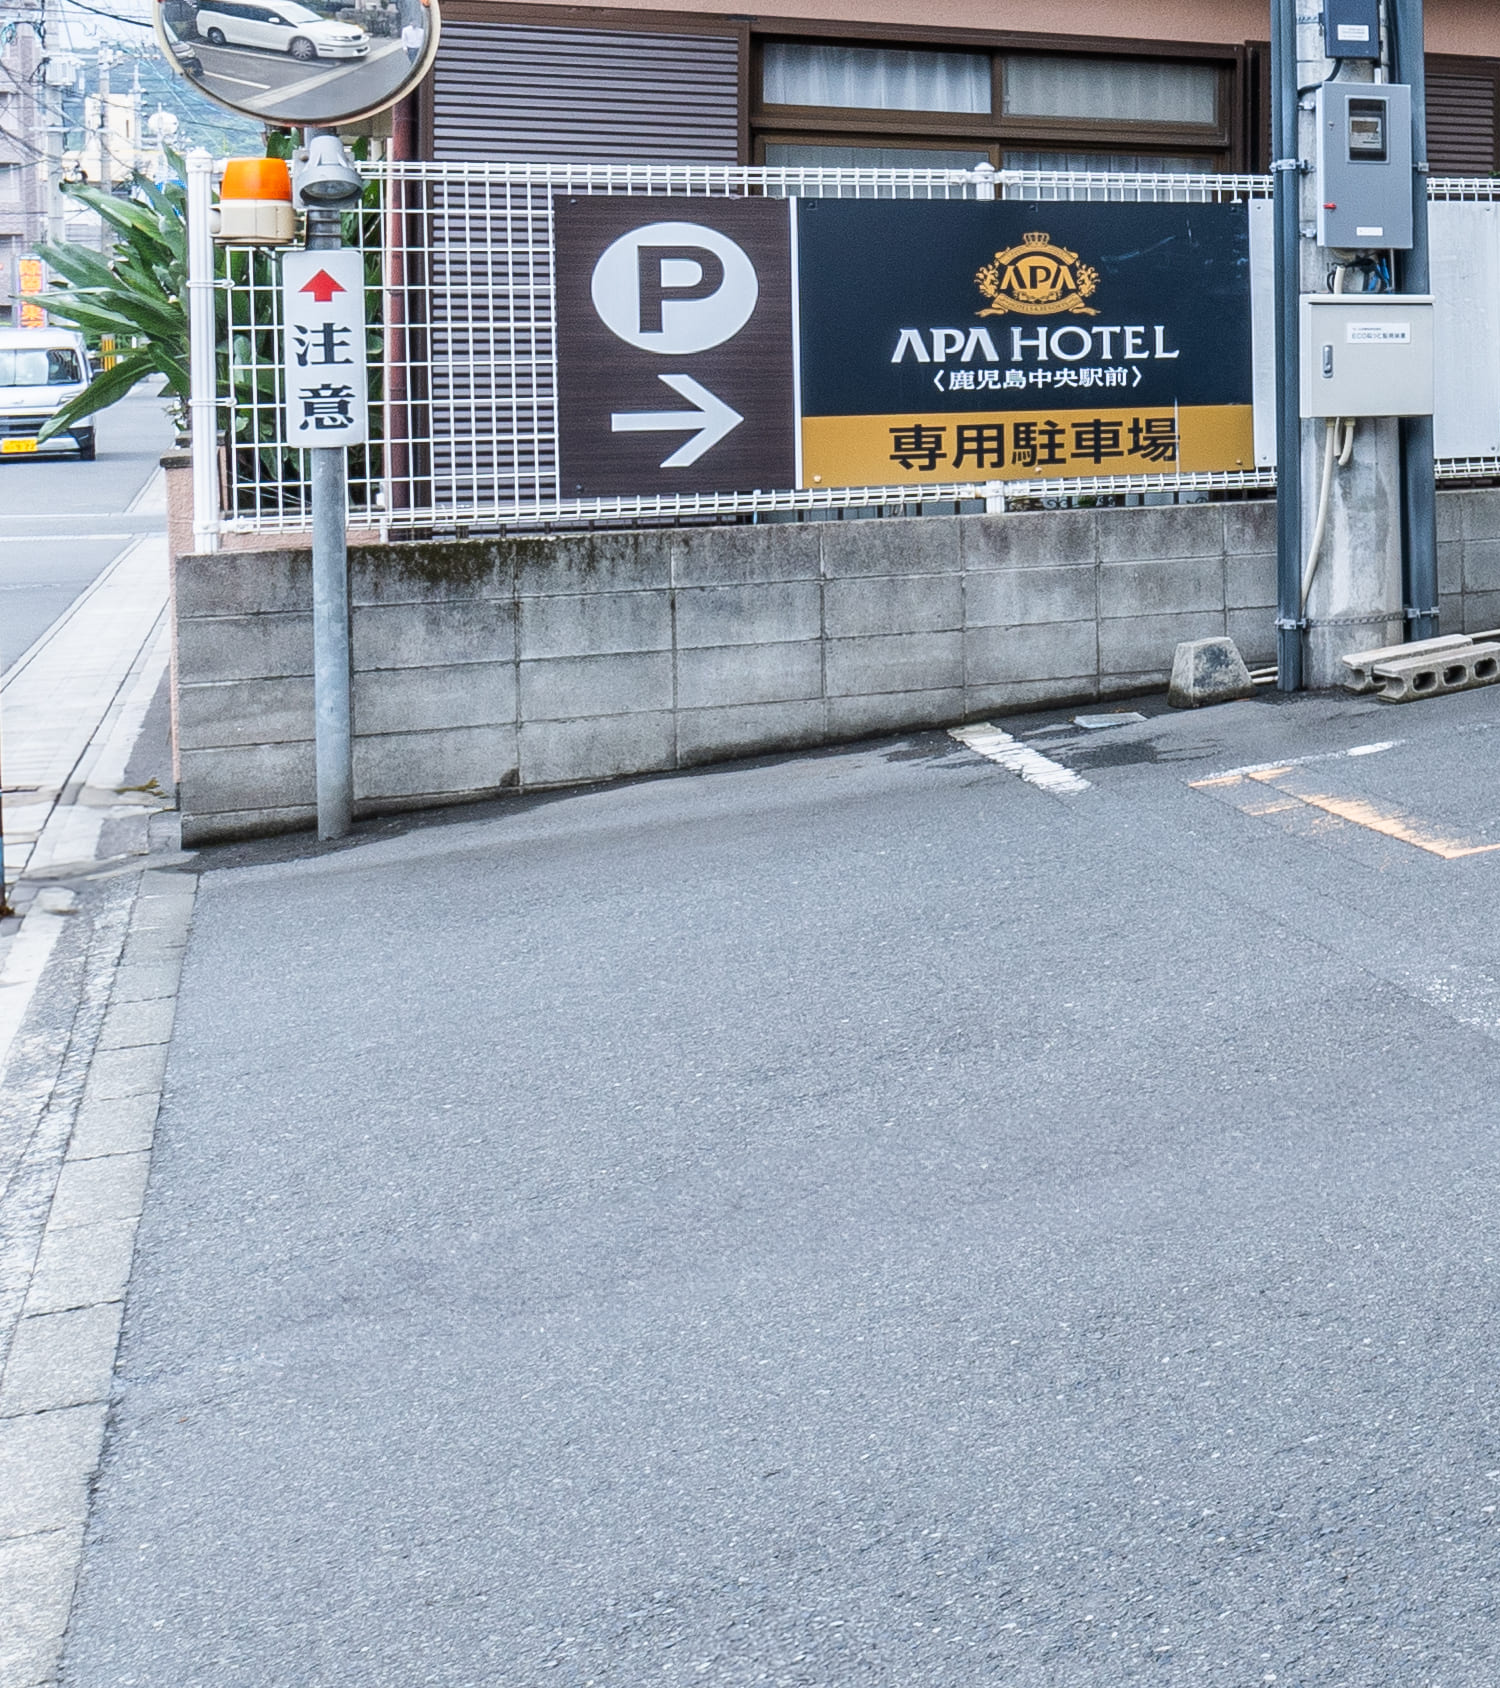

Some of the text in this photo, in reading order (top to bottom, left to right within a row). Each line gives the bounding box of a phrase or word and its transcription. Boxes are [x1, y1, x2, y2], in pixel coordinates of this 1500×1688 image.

[640, 245, 724, 334] P
[1000, 264, 1077, 290] APA
[891, 323, 1180, 364] APA HOTEL
[292, 320, 355, 434] 注意
[889, 416, 1182, 474] 専用駐車場
